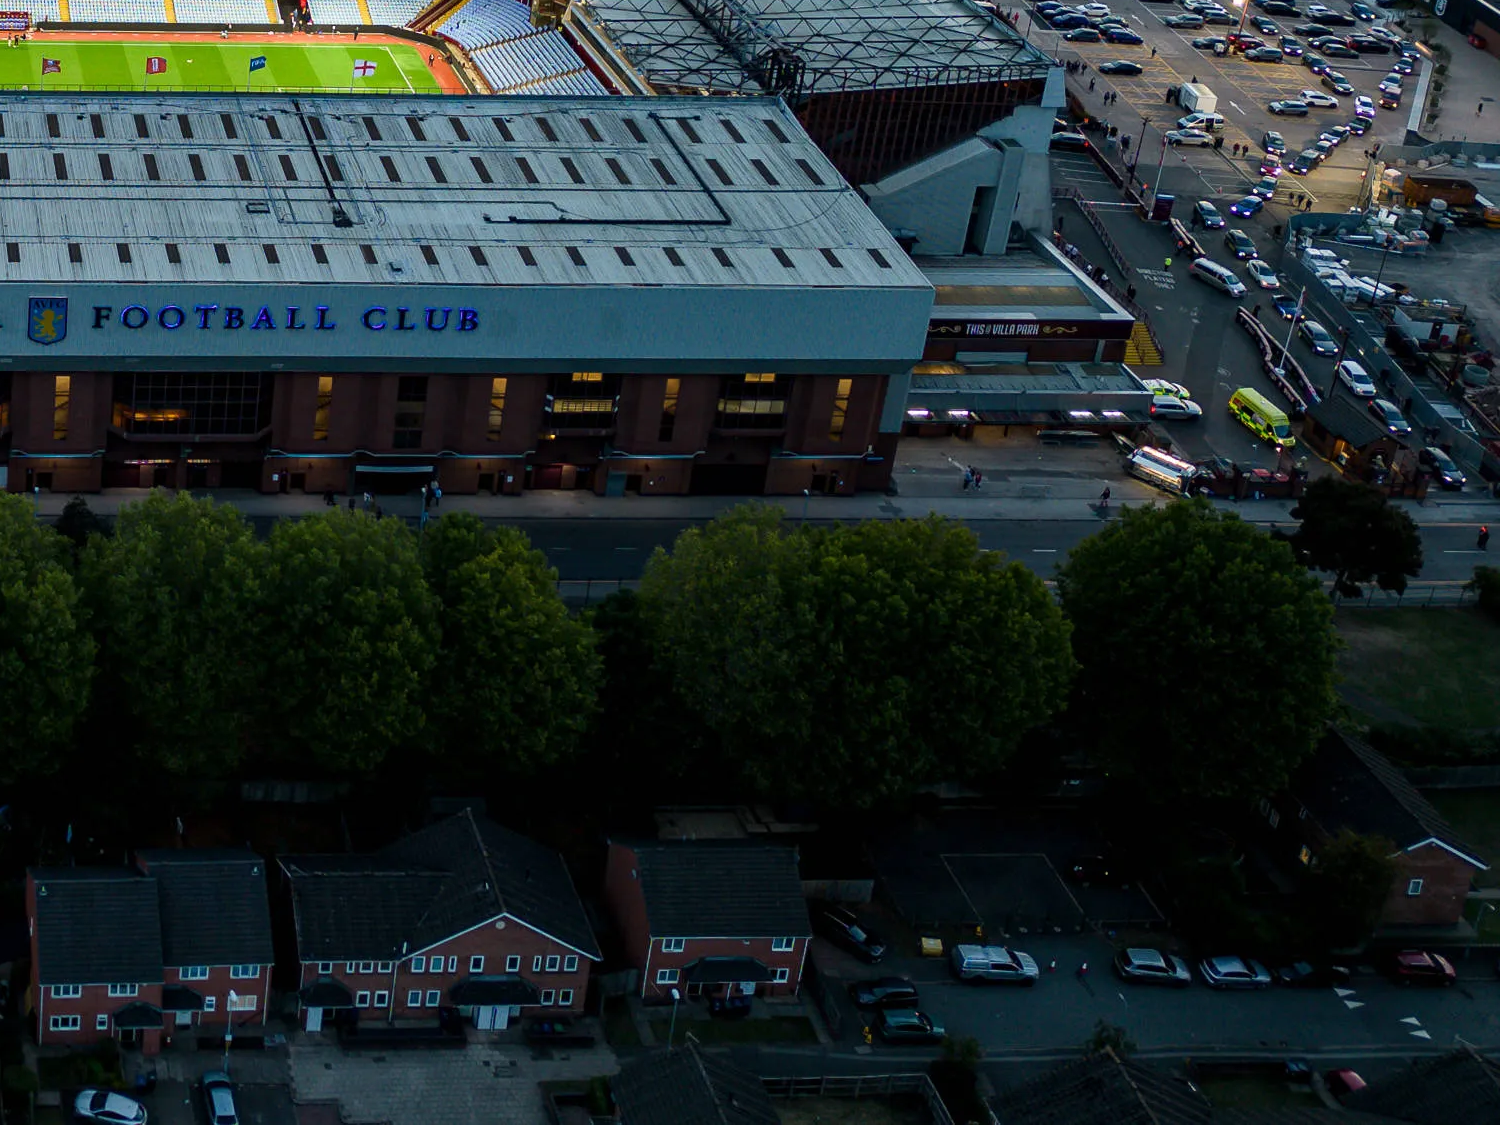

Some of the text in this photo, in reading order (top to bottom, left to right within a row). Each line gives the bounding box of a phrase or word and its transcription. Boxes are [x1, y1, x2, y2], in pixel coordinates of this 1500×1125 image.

[91, 305, 337, 331] FOOTBALL
[361, 307, 479, 333] CLUB
[966, 323, 986, 336] THIS
[992, 323, 1016, 336] VILLA
[1016, 324, 1040, 336] PARK
